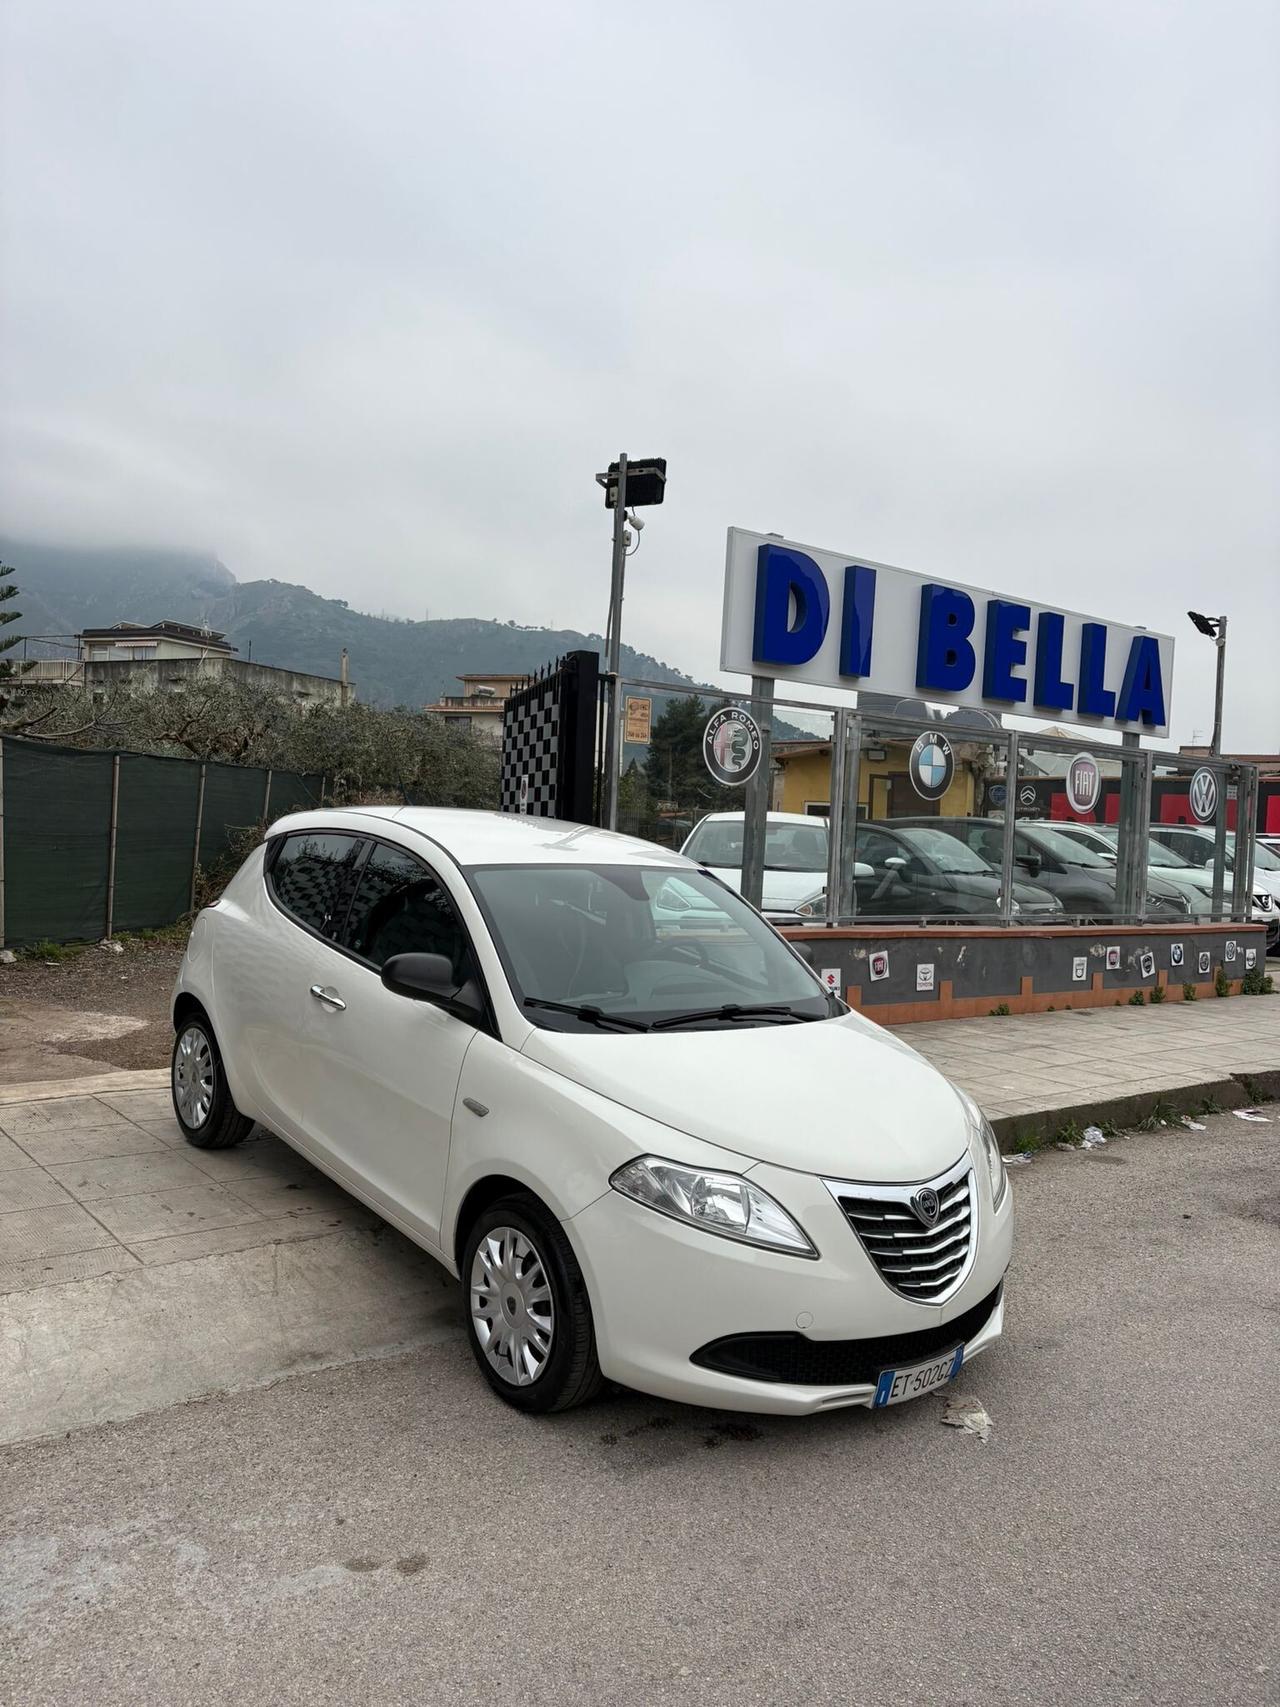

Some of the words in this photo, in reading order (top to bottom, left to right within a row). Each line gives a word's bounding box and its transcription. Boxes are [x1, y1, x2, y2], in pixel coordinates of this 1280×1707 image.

[752, 543, 877, 678] DI
[916, 583, 1166, 726] BELLA
[706, 714, 727, 745] ALFA
[731, 711, 759, 750] ROMEO
[915, 733, 951, 756] BMW
[1074, 770, 1094, 796] FIAT
